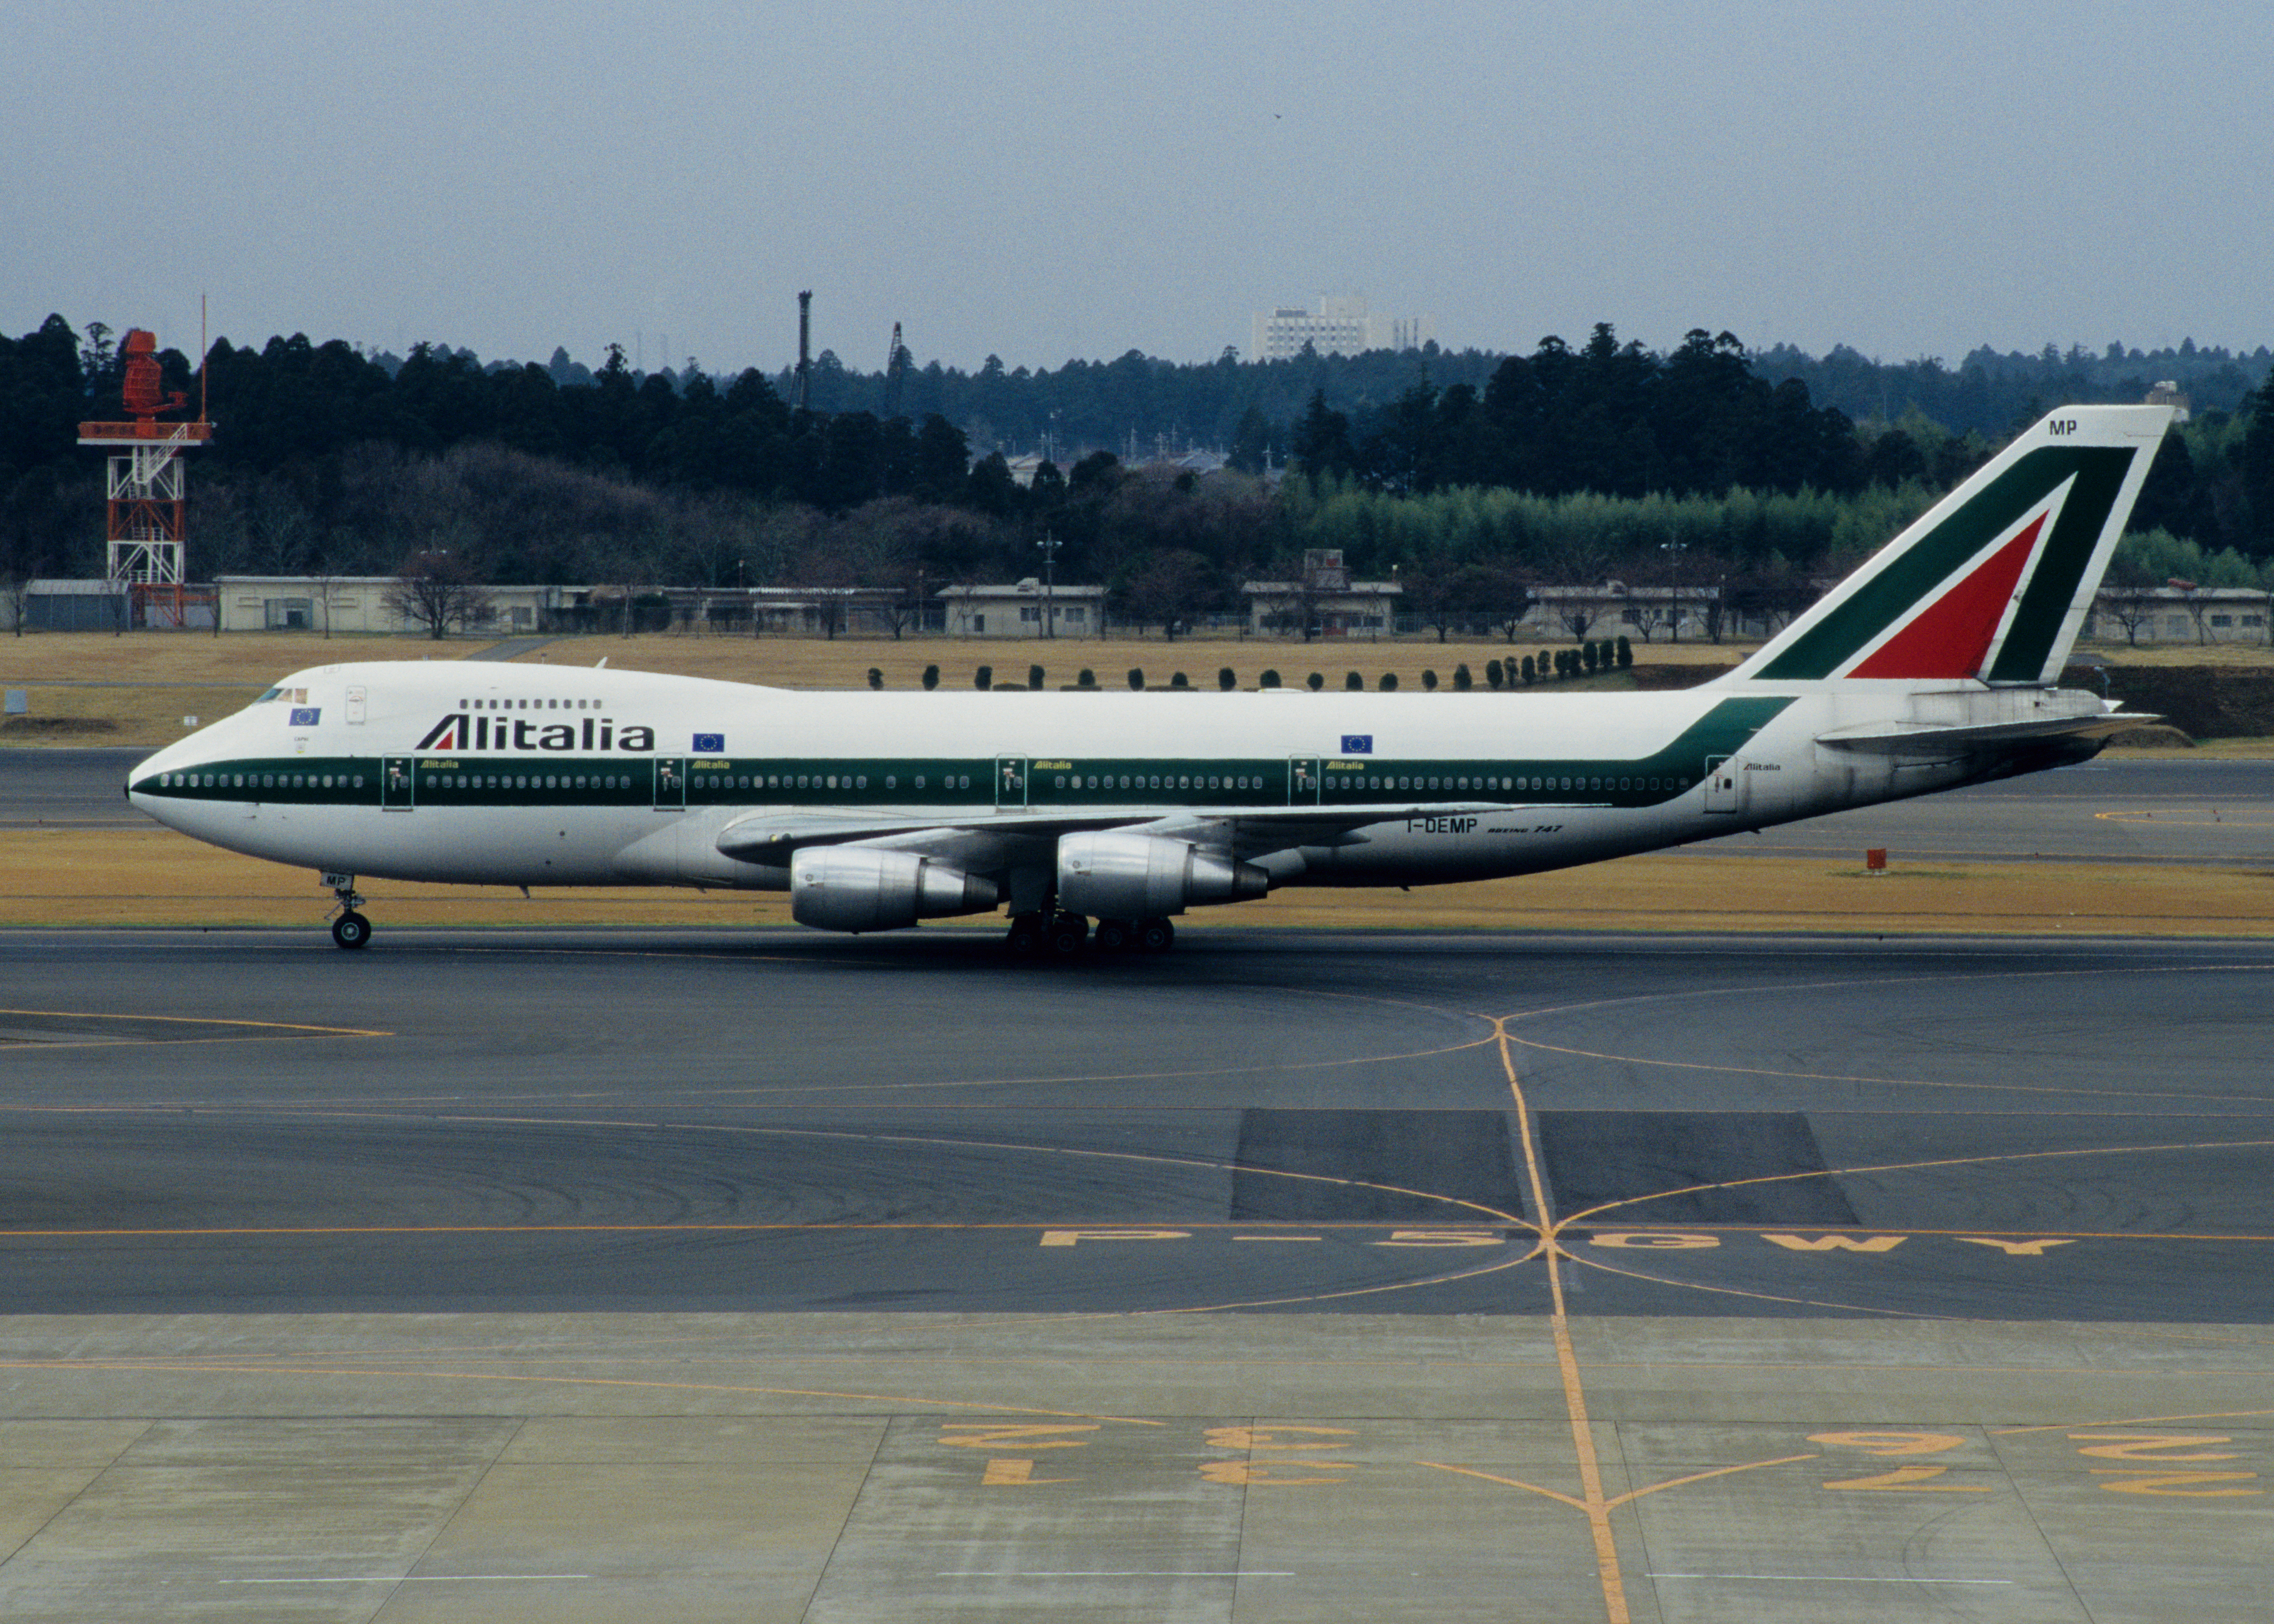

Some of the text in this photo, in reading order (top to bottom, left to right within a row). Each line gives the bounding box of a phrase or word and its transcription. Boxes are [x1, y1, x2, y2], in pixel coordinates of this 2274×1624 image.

[2049, 420, 2077, 435] MP
[414, 714, 655, 751] Alitalia
[420, 759, 459, 768] Alitalia
[691, 759, 730, 769] Alitalia
[1033, 760, 1072, 769] Alitalia
[1326, 760, 1364, 770] Alitalia
[1407, 818, 1477, 834] I-DEMP
[1533, 825, 1563, 833] 747
[327, 876, 346, 885] MP
